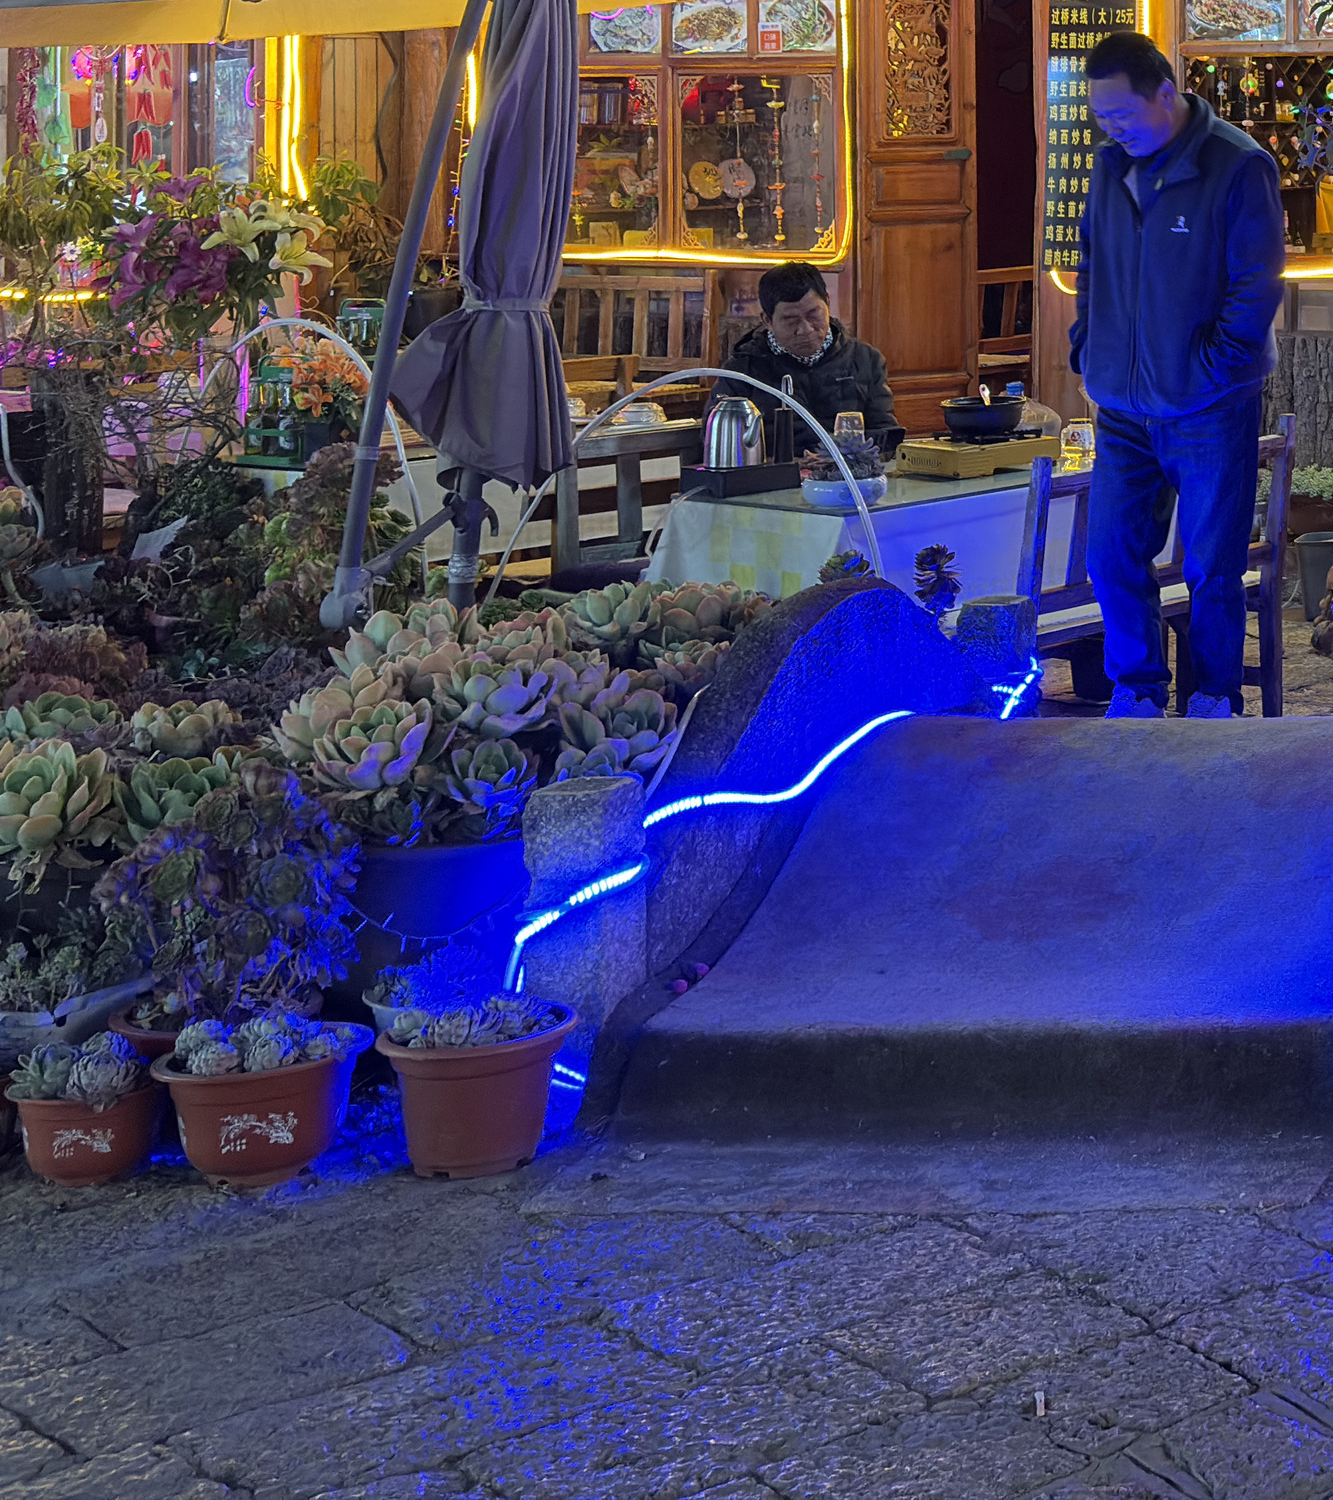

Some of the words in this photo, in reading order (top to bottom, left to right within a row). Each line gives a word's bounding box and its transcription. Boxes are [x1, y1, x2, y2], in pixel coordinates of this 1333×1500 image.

[1115, 8, 1134, 25] 25元
[1049, 79, 1092, 97] 野生菌米
[1049, 104, 1088, 121] 鸡蛋炒饭
[1048, 128, 1092, 146] 纳西炒饭
[1047, 152, 1094, 170] 扬州炒饭
[1046, 176, 1090, 194] 牛肉炒饭
[1044, 248, 1083, 267] 腊肉牛肝
